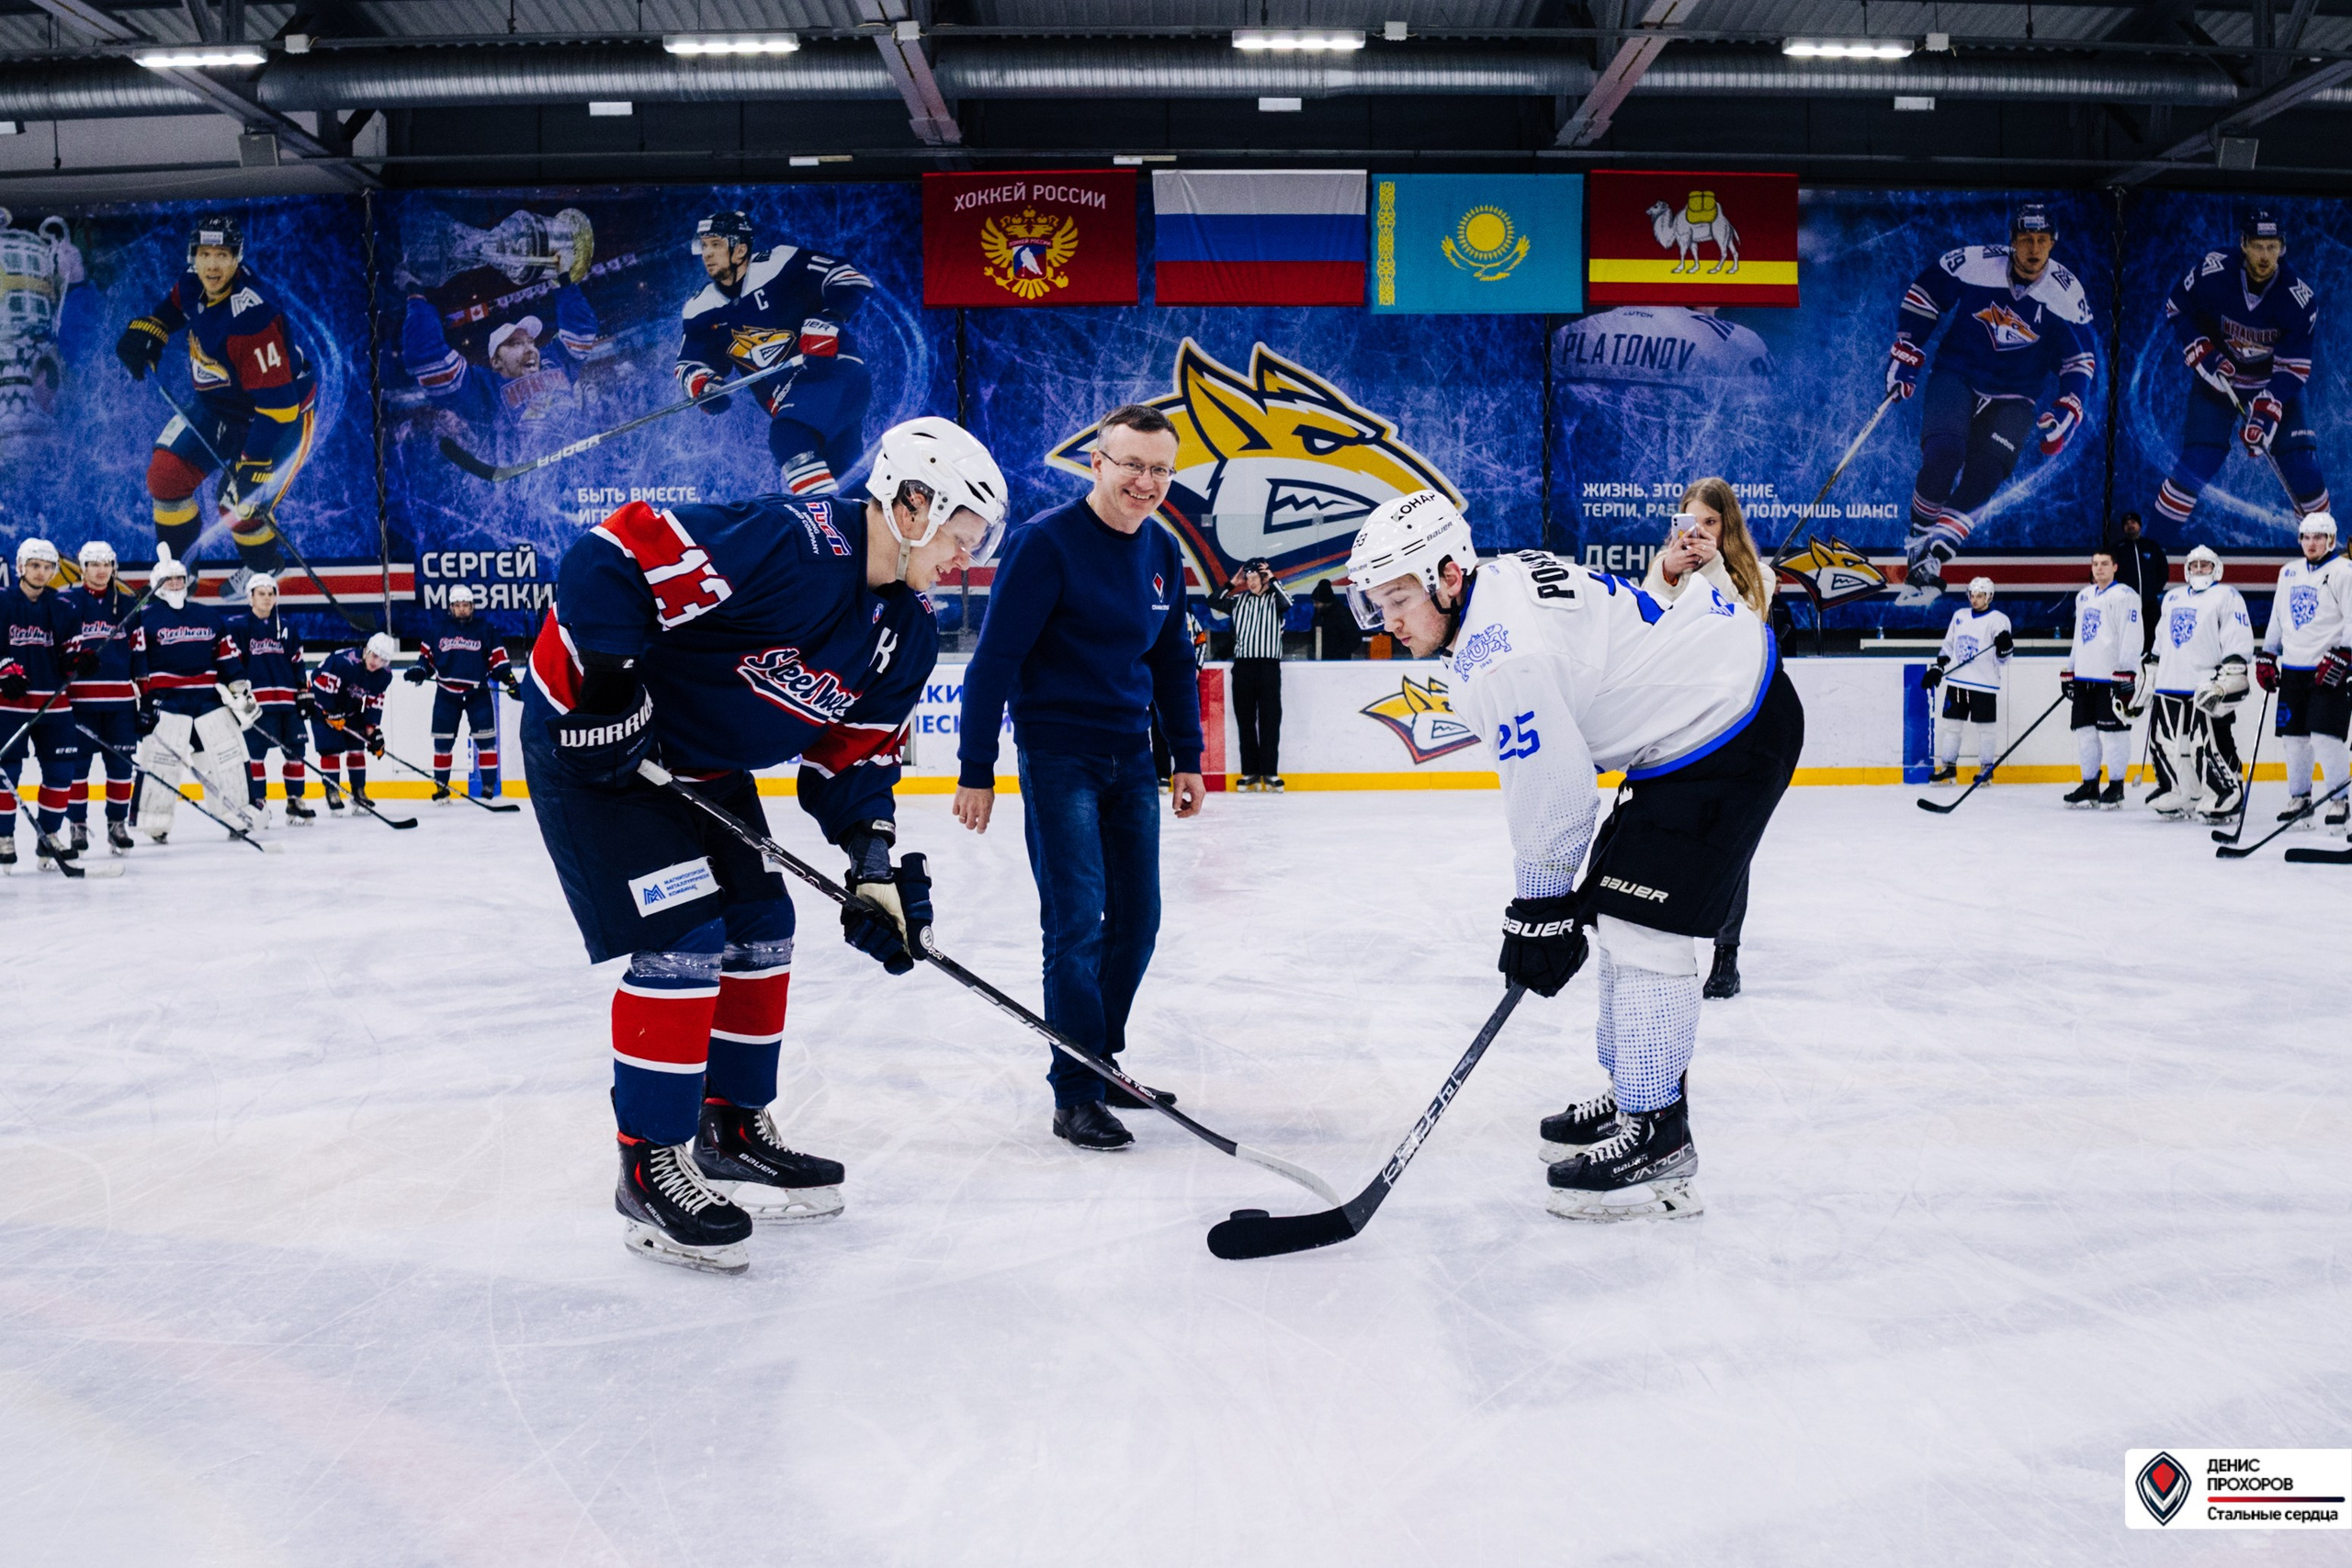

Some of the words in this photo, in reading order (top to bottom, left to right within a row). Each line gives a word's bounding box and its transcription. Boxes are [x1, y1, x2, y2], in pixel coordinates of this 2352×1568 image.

[954, 182, 1026, 212] ХОККЕЙ
[1033, 185, 1106, 209] РОССИИ
[254, 341, 282, 374] 14
[1562, 332, 1696, 371] PLATONOV
[578, 488, 626, 503] БЫТЬ
[630, 487, 701, 503] ВМЕСТЕ,
[1583, 483, 1648, 499] ЖИЗНЬ,
[1653, 484, 1683, 497] ЭТО
[1583, 503, 1642, 519] ТЕРПИ,
[1747, 503, 1841, 519] ПОЛУЧИШЬ
[1847, 503, 1898, 519] ШАНС!
[801, 519, 820, 555] COMPANY
[1427, 521, 1453, 542] BAUER
[422, 545, 537, 578] СЕРГЕЙ
[424, 583, 558, 610] МЗЯКИ
[1498, 710, 1541, 761] 25
[1600, 875, 1669, 904] BAUER
[1501, 916, 1575, 938] BAUER
[738, 1152, 779, 1178] BAUER
